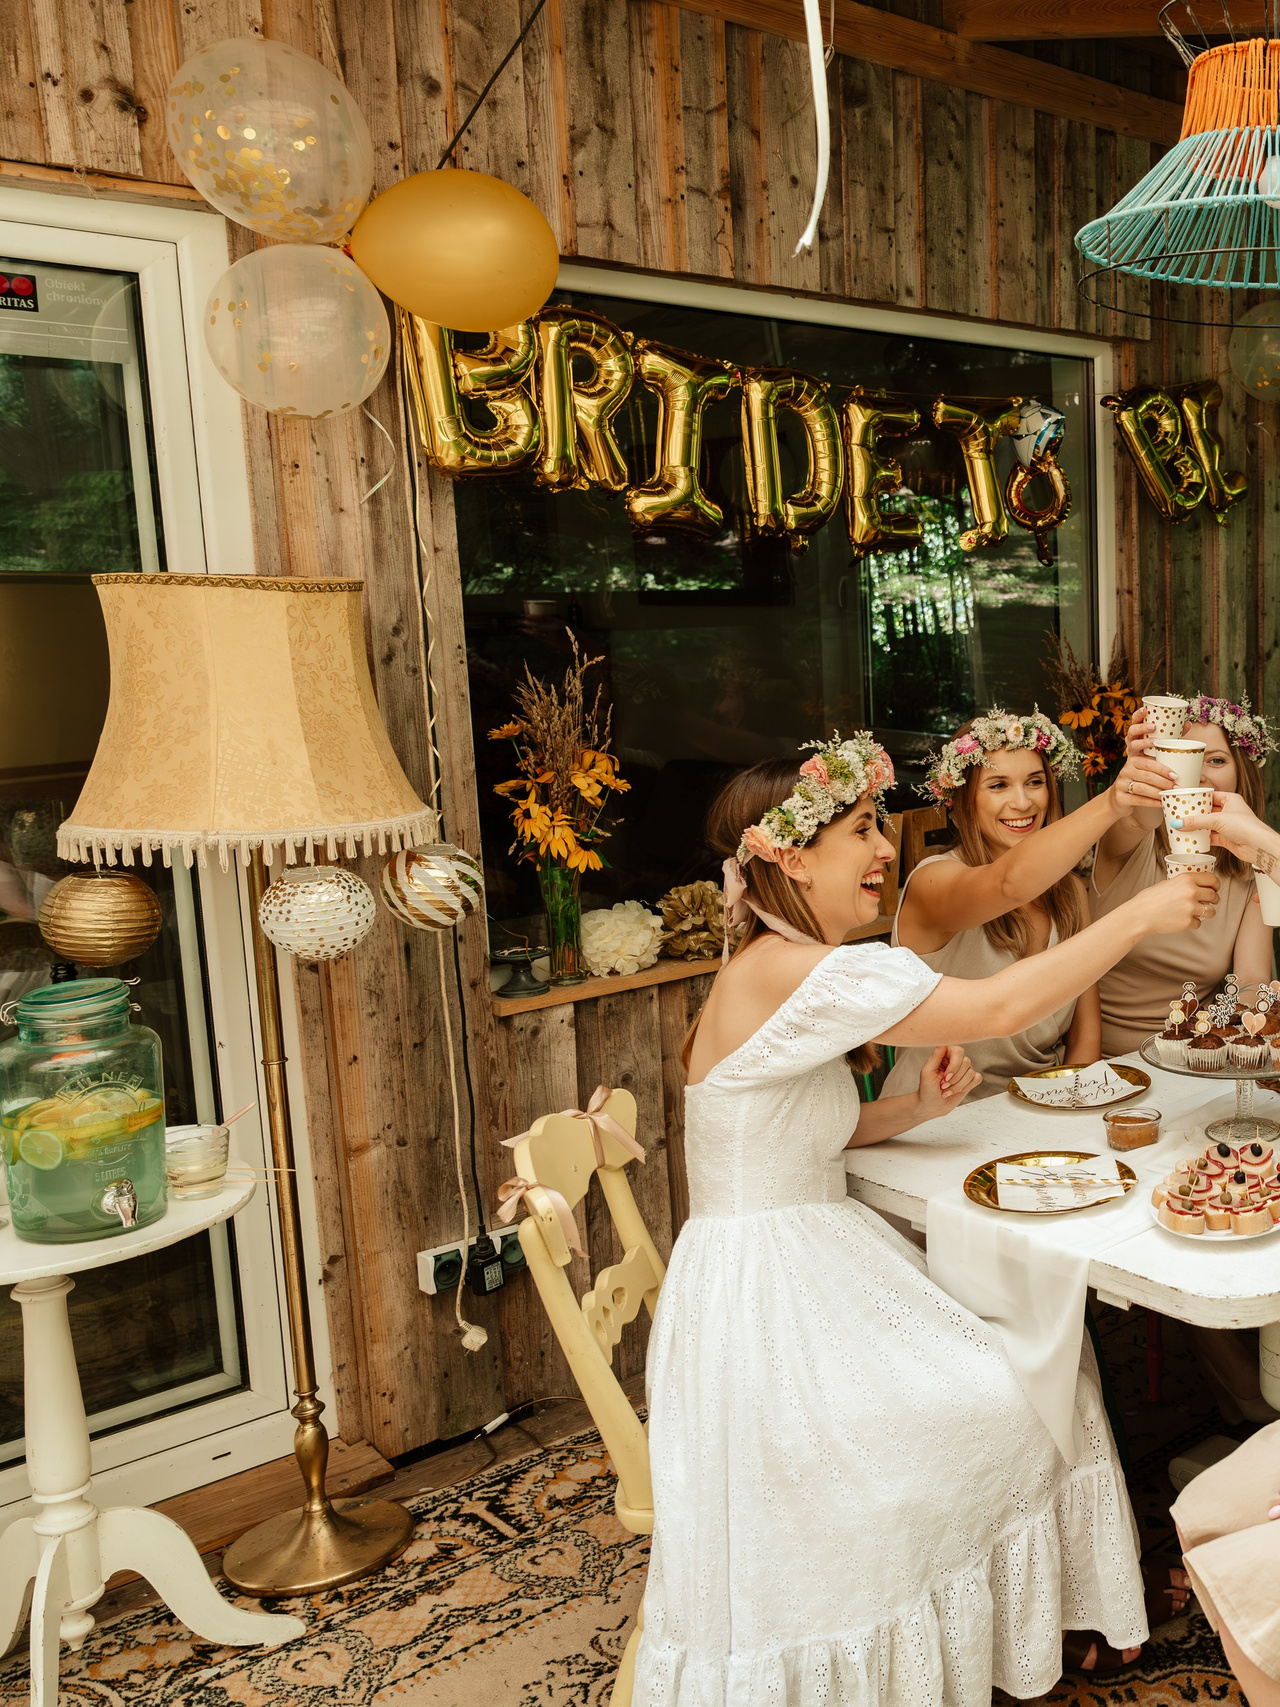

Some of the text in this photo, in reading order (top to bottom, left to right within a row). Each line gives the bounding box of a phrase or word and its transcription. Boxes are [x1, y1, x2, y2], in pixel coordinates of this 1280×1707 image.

[45, 278, 86, 292] Obiekt
[46, 291, 108, 308] chroniony
[402, 304, 925, 558] BRIDE
